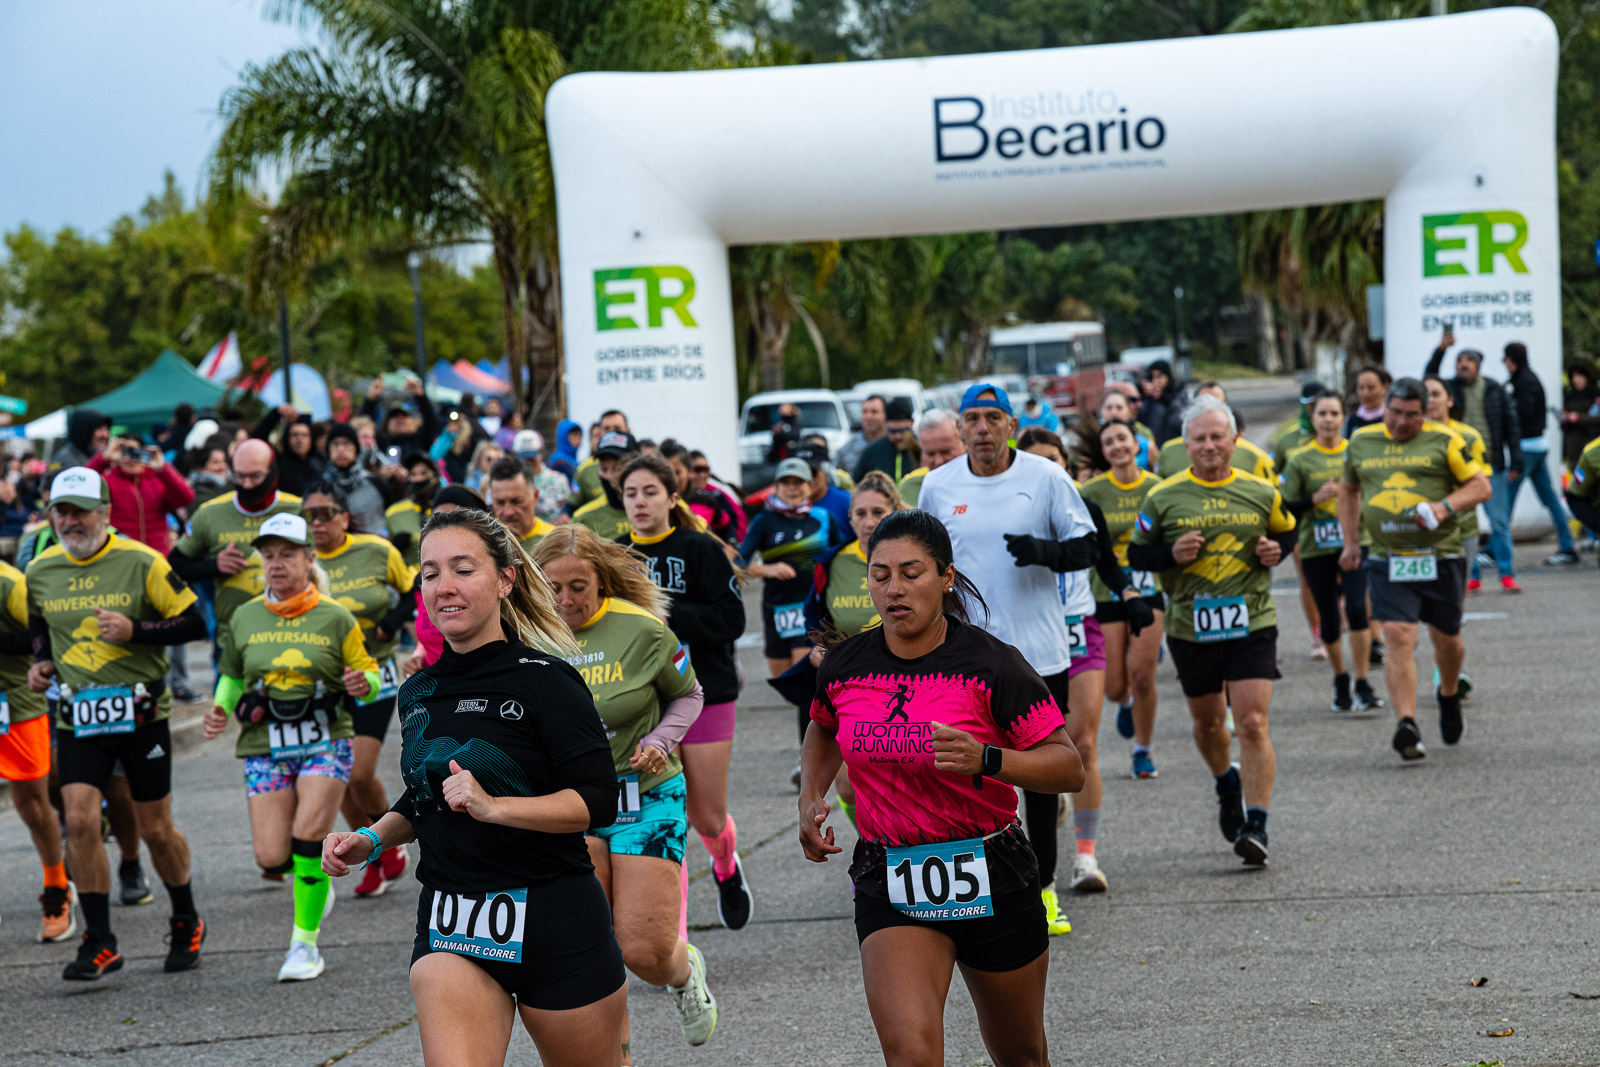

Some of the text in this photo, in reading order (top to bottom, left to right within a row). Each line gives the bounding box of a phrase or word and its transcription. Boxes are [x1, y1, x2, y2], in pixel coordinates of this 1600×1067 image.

[991, 88, 1118, 119] Instituto
[934, 97, 1166, 163] Becario
[1422, 211, 1529, 278] ER
[593, 266, 698, 332] ER
[1422, 290, 1533, 309] GOBIERNO DE
[1422, 312, 1485, 332] ENTRE
[597, 344, 703, 362] GOBIERNO DE
[597, 365, 656, 384] ENTRE
[1361, 456, 1431, 469] ANIVERSARIO
[1177, 512, 1260, 528] ANIVERSARIO
[1394, 557, 1432, 577] 246
[44, 593, 131, 612] ANIVERSARIO
[1198, 604, 1243, 632] 012
[247, 631, 331, 647] ANIVERSARIO
[580, 661, 624, 686] ORIA
[79, 695, 126, 725] 069
[274, 720, 322, 747] 113
[854, 723, 932, 738] WOMAN
[852, 739, 936, 754] RUNNING
[894, 852, 980, 907] 105
[436, 892, 516, 945] 070
[951, 905, 987, 917] CORRE
[432, 939, 516, 959] DIAMANTE CORRE
